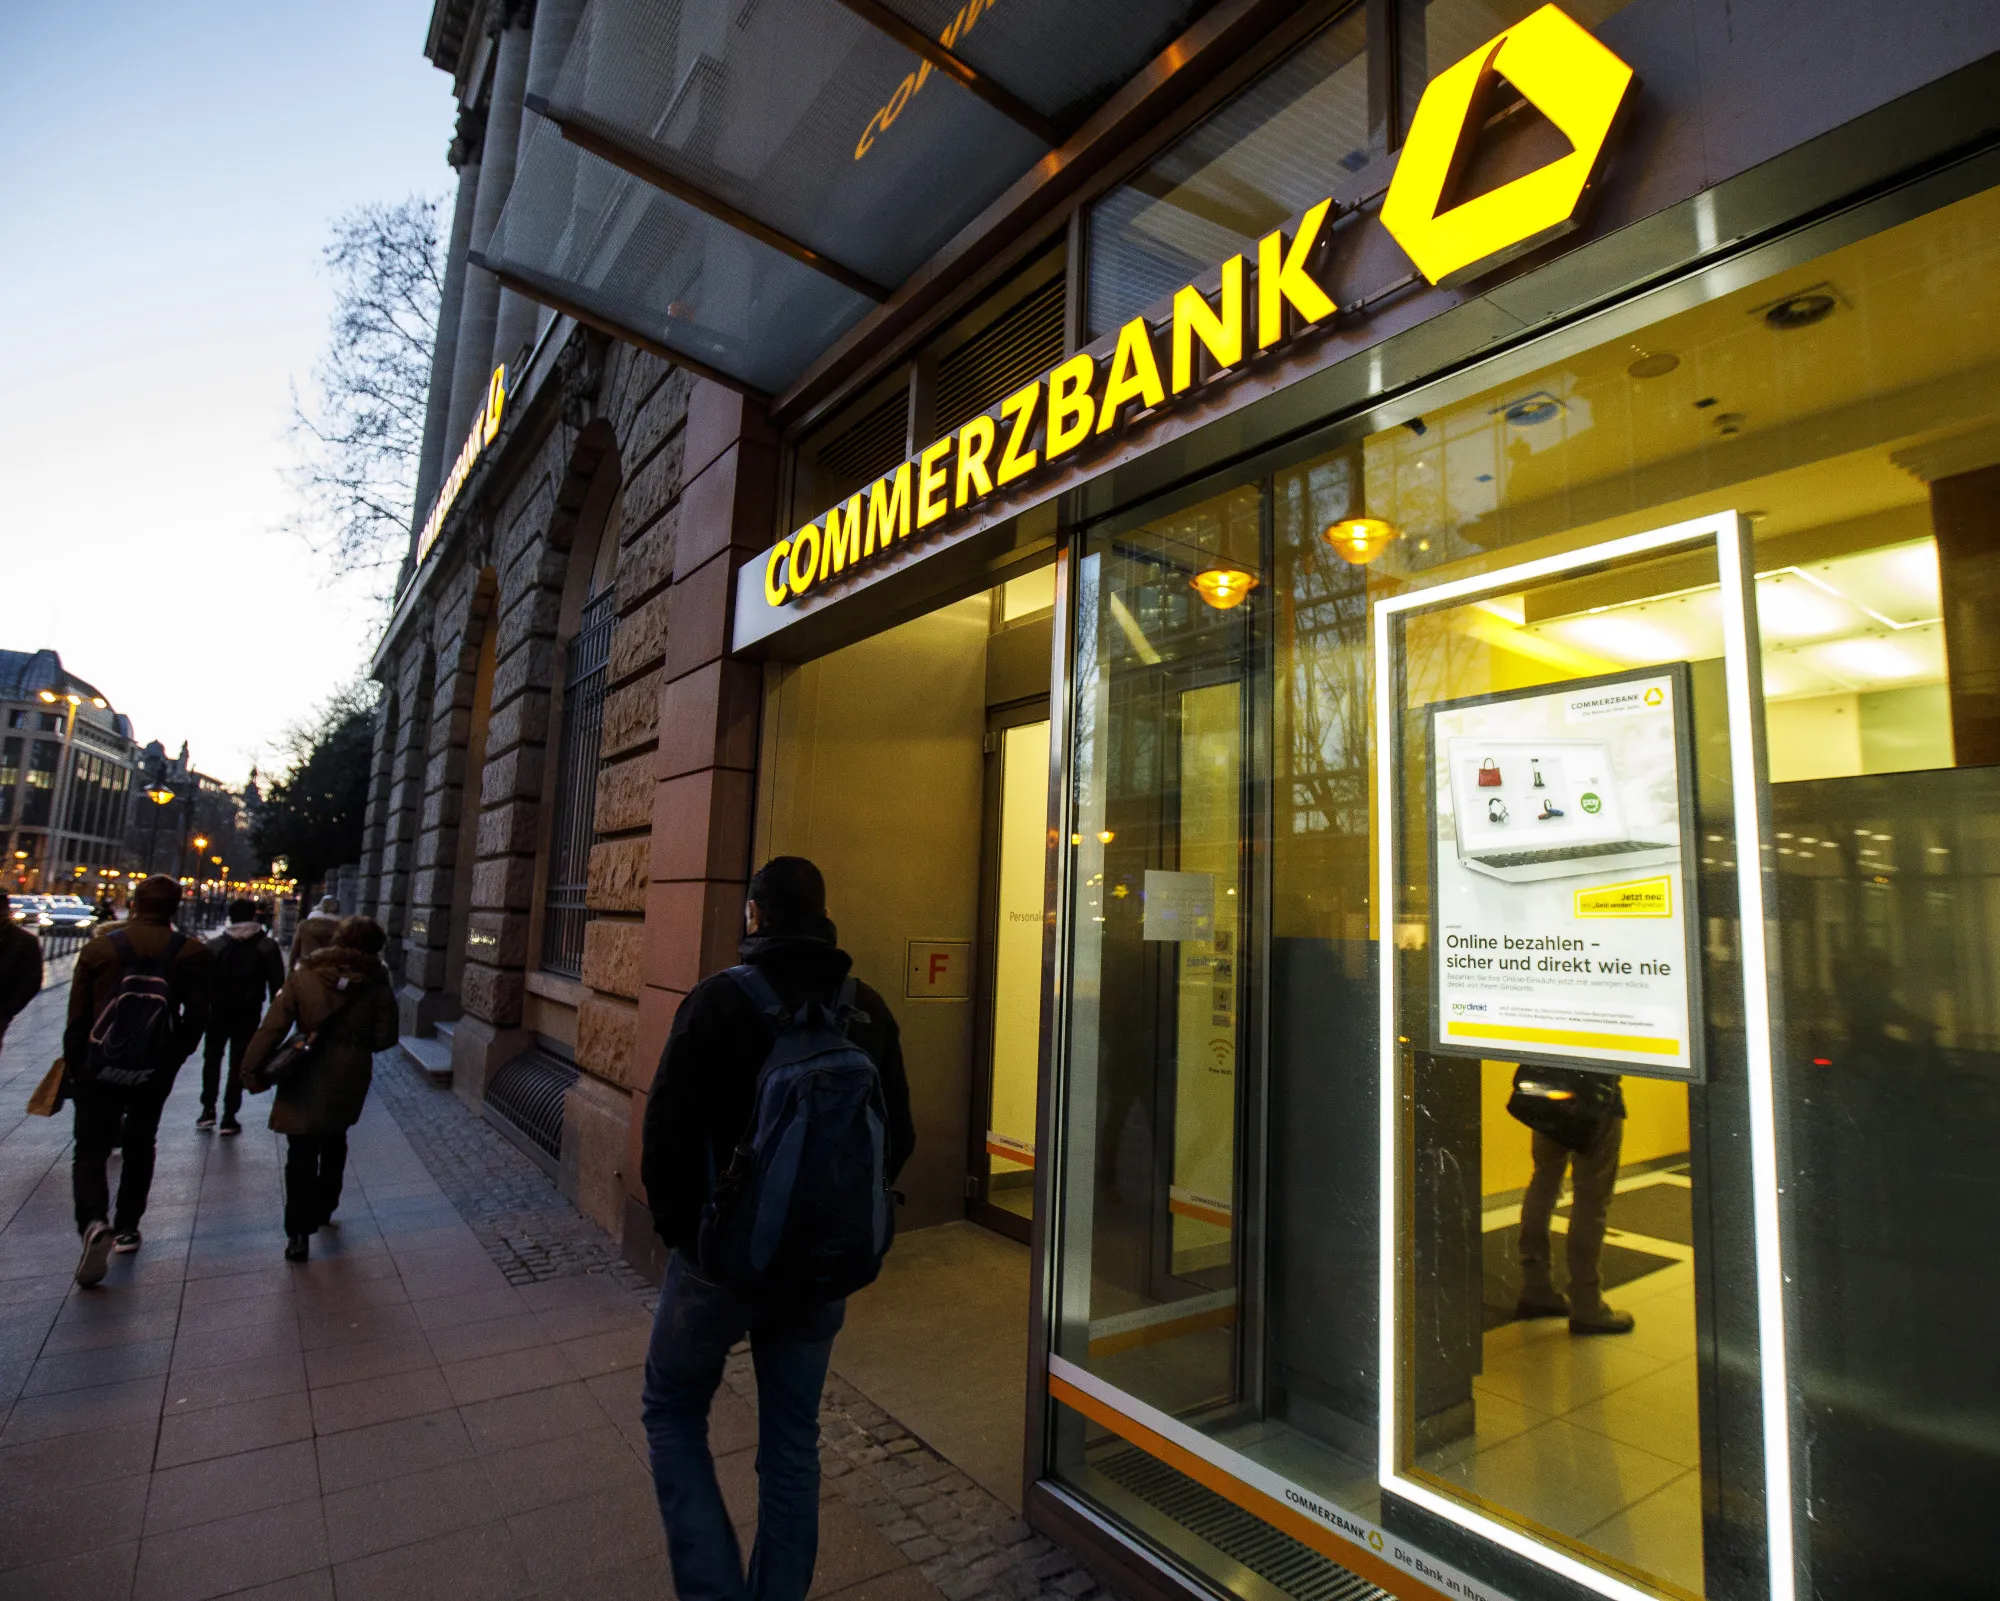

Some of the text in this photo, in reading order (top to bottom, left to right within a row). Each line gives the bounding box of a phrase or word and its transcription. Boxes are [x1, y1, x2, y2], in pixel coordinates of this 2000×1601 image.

[764, 198, 1338, 607] COMMERZBANK
[1571, 694, 1640, 710] COMMERZBANK
[1621, 893, 1643, 901] Jetzt
[1446, 934, 1498, 949] Online
[1504, 934, 1584, 951] bezahlen
[929, 953, 949, 984] F
[1446, 953, 1671, 976] sicher und direkt wie nie
[95, 1065, 156, 1086] NIKE
[1284, 1488, 1366, 1542] COMMERZBANK
[1394, 1547, 1413, 1567] Die
[1415, 1558, 1444, 1585] Bank
[1446, 1577, 1461, 1593] an
